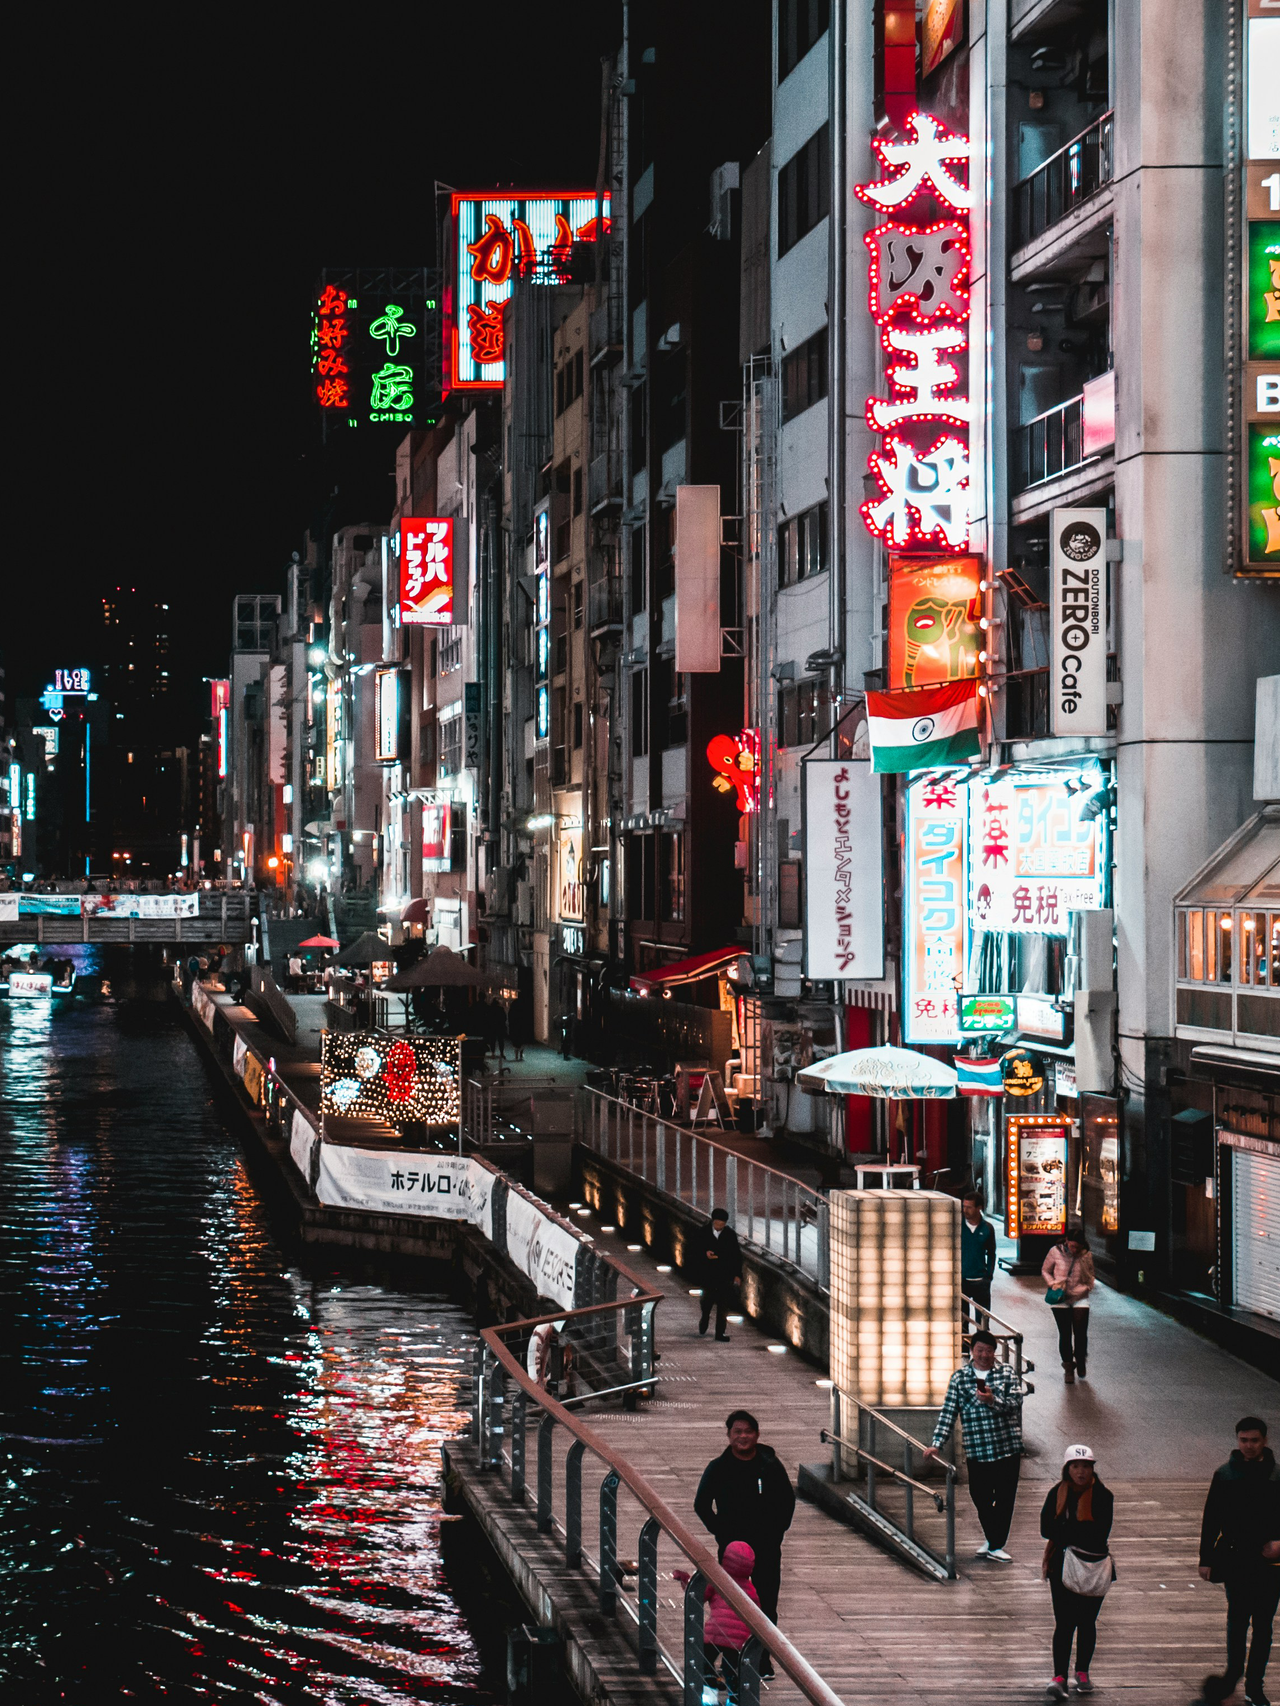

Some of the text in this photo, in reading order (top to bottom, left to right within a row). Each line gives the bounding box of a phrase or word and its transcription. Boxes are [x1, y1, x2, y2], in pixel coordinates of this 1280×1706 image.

[317, 285, 349, 408] お好み焼
[855, 112, 972, 552] 大阪王将
[369, 412, 415, 423] CHIBO
[405, 532, 426, 598] ドラッグ
[425, 522, 449, 583] ツルハ
[1061, 568, 1090, 715] ZERO Cafe
[1090, 568, 1100, 635] DOUTONBORI
[833, 767, 855, 971] よしもとエンタメショップ
[920, 817, 958, 931] ダイコク
[1011, 884, 1059, 925] 免税
